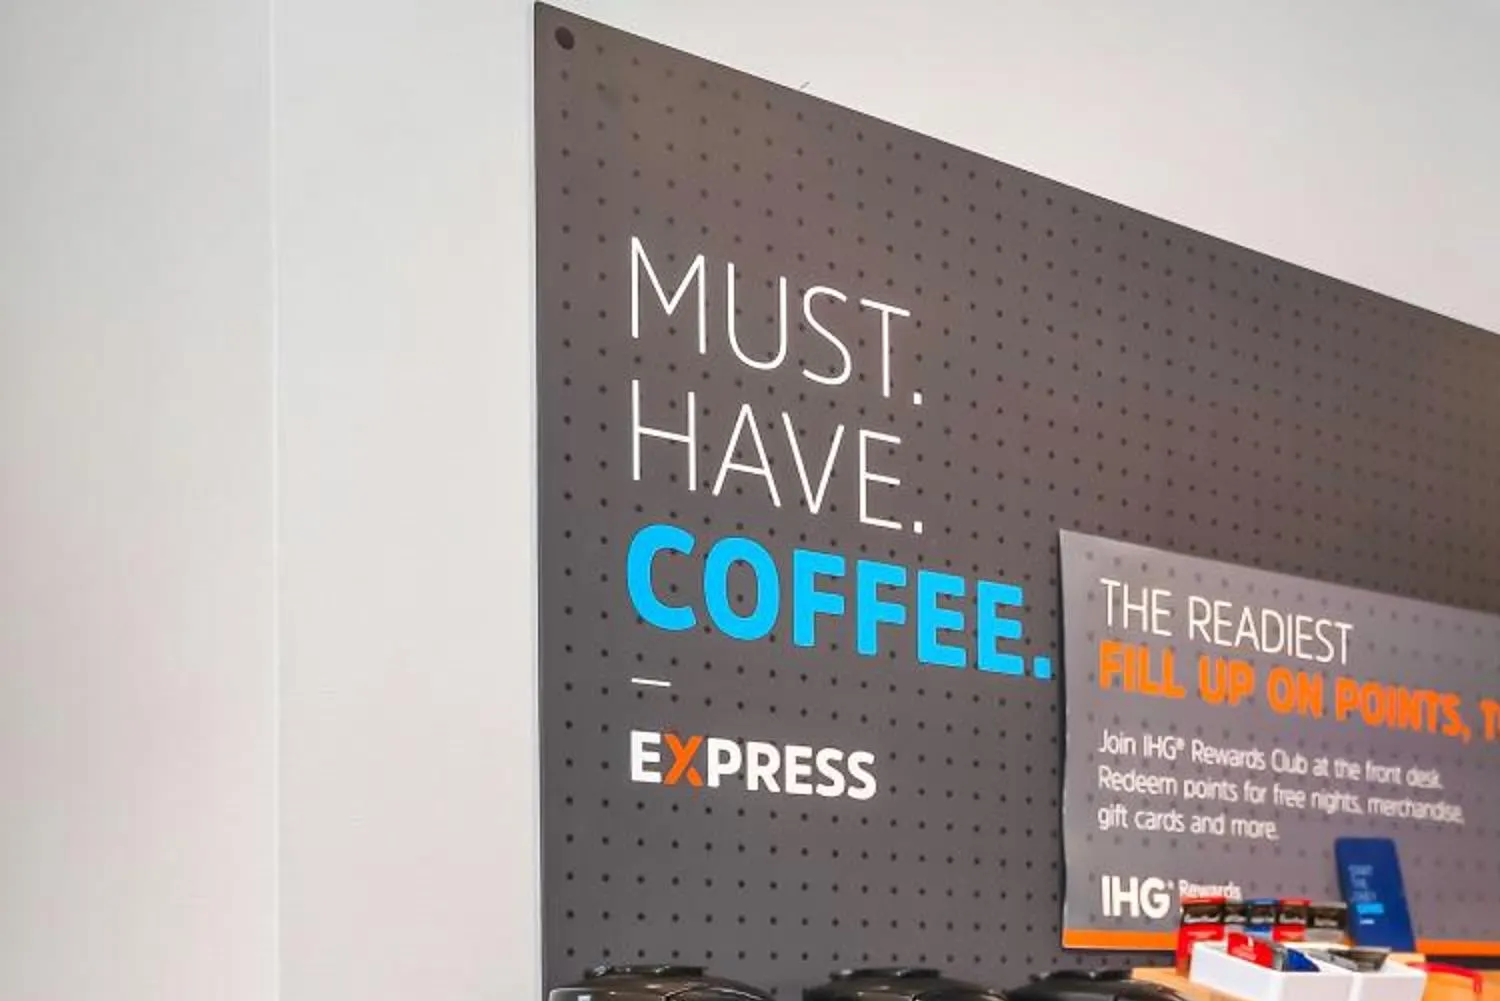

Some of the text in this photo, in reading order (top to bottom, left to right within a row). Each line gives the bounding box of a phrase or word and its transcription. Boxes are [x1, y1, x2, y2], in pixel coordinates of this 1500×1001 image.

[631, 236, 922, 405] MUST.
[632, 379, 923, 533] HAVE.
[626, 524, 1052, 679] COFFEE.
[1100, 577, 1354, 665] THE READIEST
[1099, 639, 1187, 699] FILL
[1199, 655, 1256, 706] UP
[1266, 666, 1324, 719] ON
[1335, 675, 1472, 744] POINTS,
[630, 728, 877, 800] EXPRESS
[1097, 729, 1137, 756] Join
[1191, 738, 1266, 771] Rewards
[1271, 748, 1308, 775] Club
[1312, 756, 1329, 777] at
[1334, 758, 1361, 781] the
[1365, 760, 1402, 784] front
[1098, 765, 1178, 797] Redeem
[1183, 777, 1238, 802] points
[1243, 779, 1268, 805] for
[1273, 783, 1306, 809] free
[1097, 803, 1129, 831] gift
[1134, 808, 1185, 833] cards
[1190, 812, 1225, 836] and
